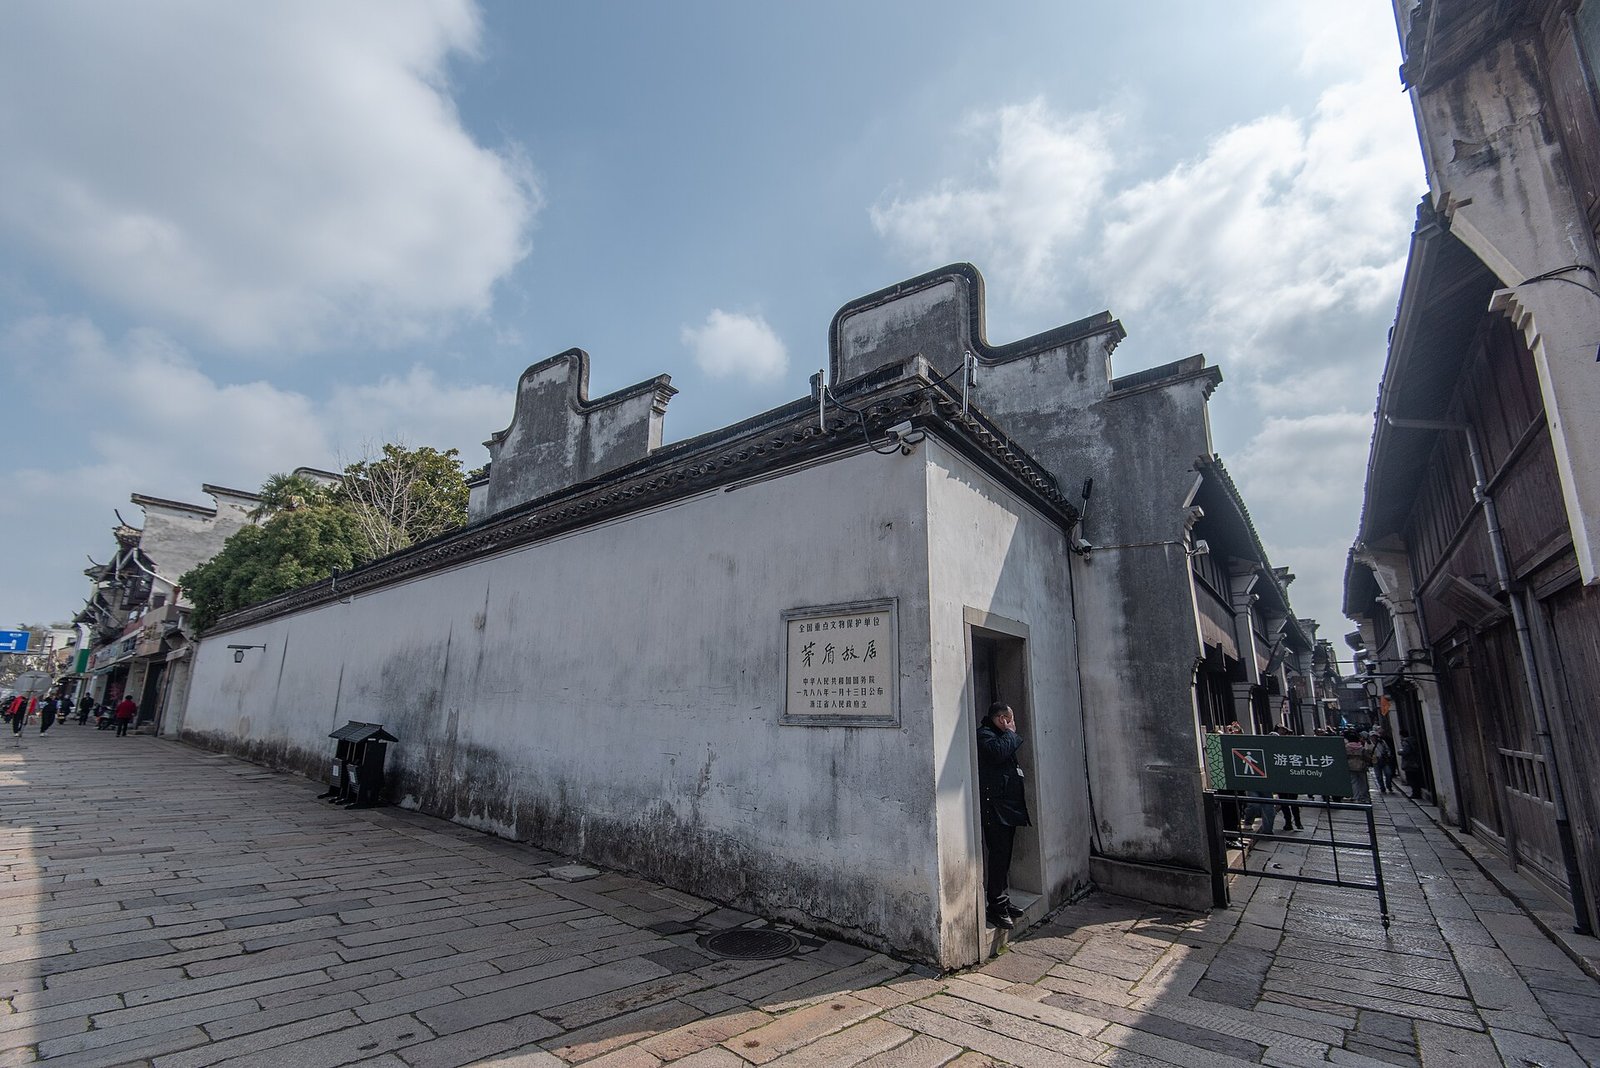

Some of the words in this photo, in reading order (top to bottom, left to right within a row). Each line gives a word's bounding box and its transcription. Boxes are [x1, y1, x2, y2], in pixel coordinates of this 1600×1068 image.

[799, 617, 880, 633] 全国重点文物保护单位
[801, 640, 877, 667] 茅盾故居
[803, 676, 875, 685] 中华人民共和国国务院
[796, 687, 883, 697] 一九八八年一月十三日公布
[1273, 753, 1334, 768] 游客止步
[1289, 768, 1305, 776] Staff
[1306, 769, 1323, 777] Only
